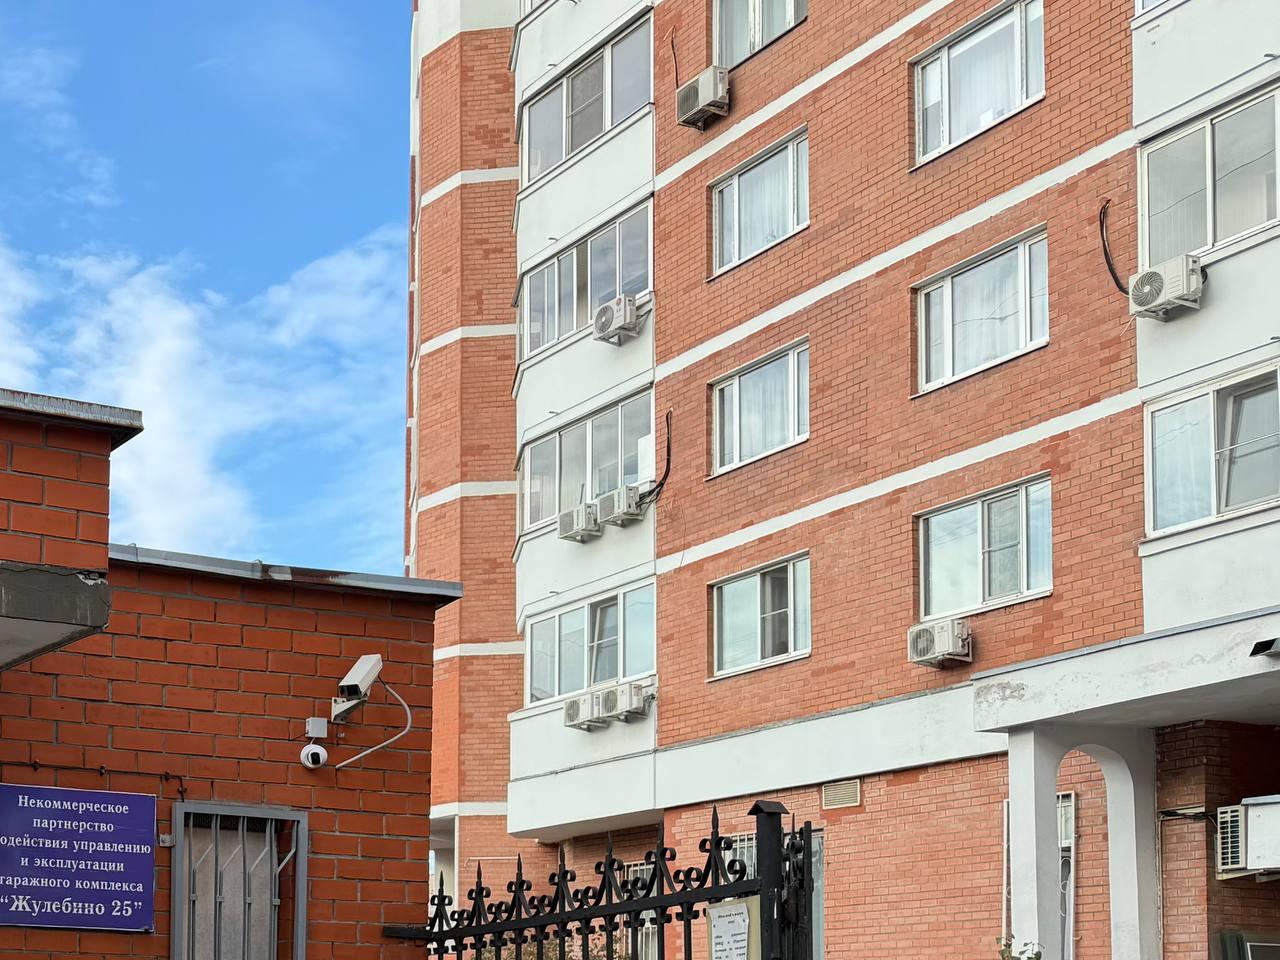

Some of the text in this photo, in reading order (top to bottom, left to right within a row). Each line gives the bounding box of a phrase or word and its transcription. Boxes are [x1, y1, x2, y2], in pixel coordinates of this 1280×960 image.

[18, 794, 129, 814] Некоммерческое
[33, 818, 114, 833] партнерство
[73, 841, 151, 854] управлению
[20, 857, 125, 873] и эксплуатации
[0, 875, 143, 892] гаражного комплекса
